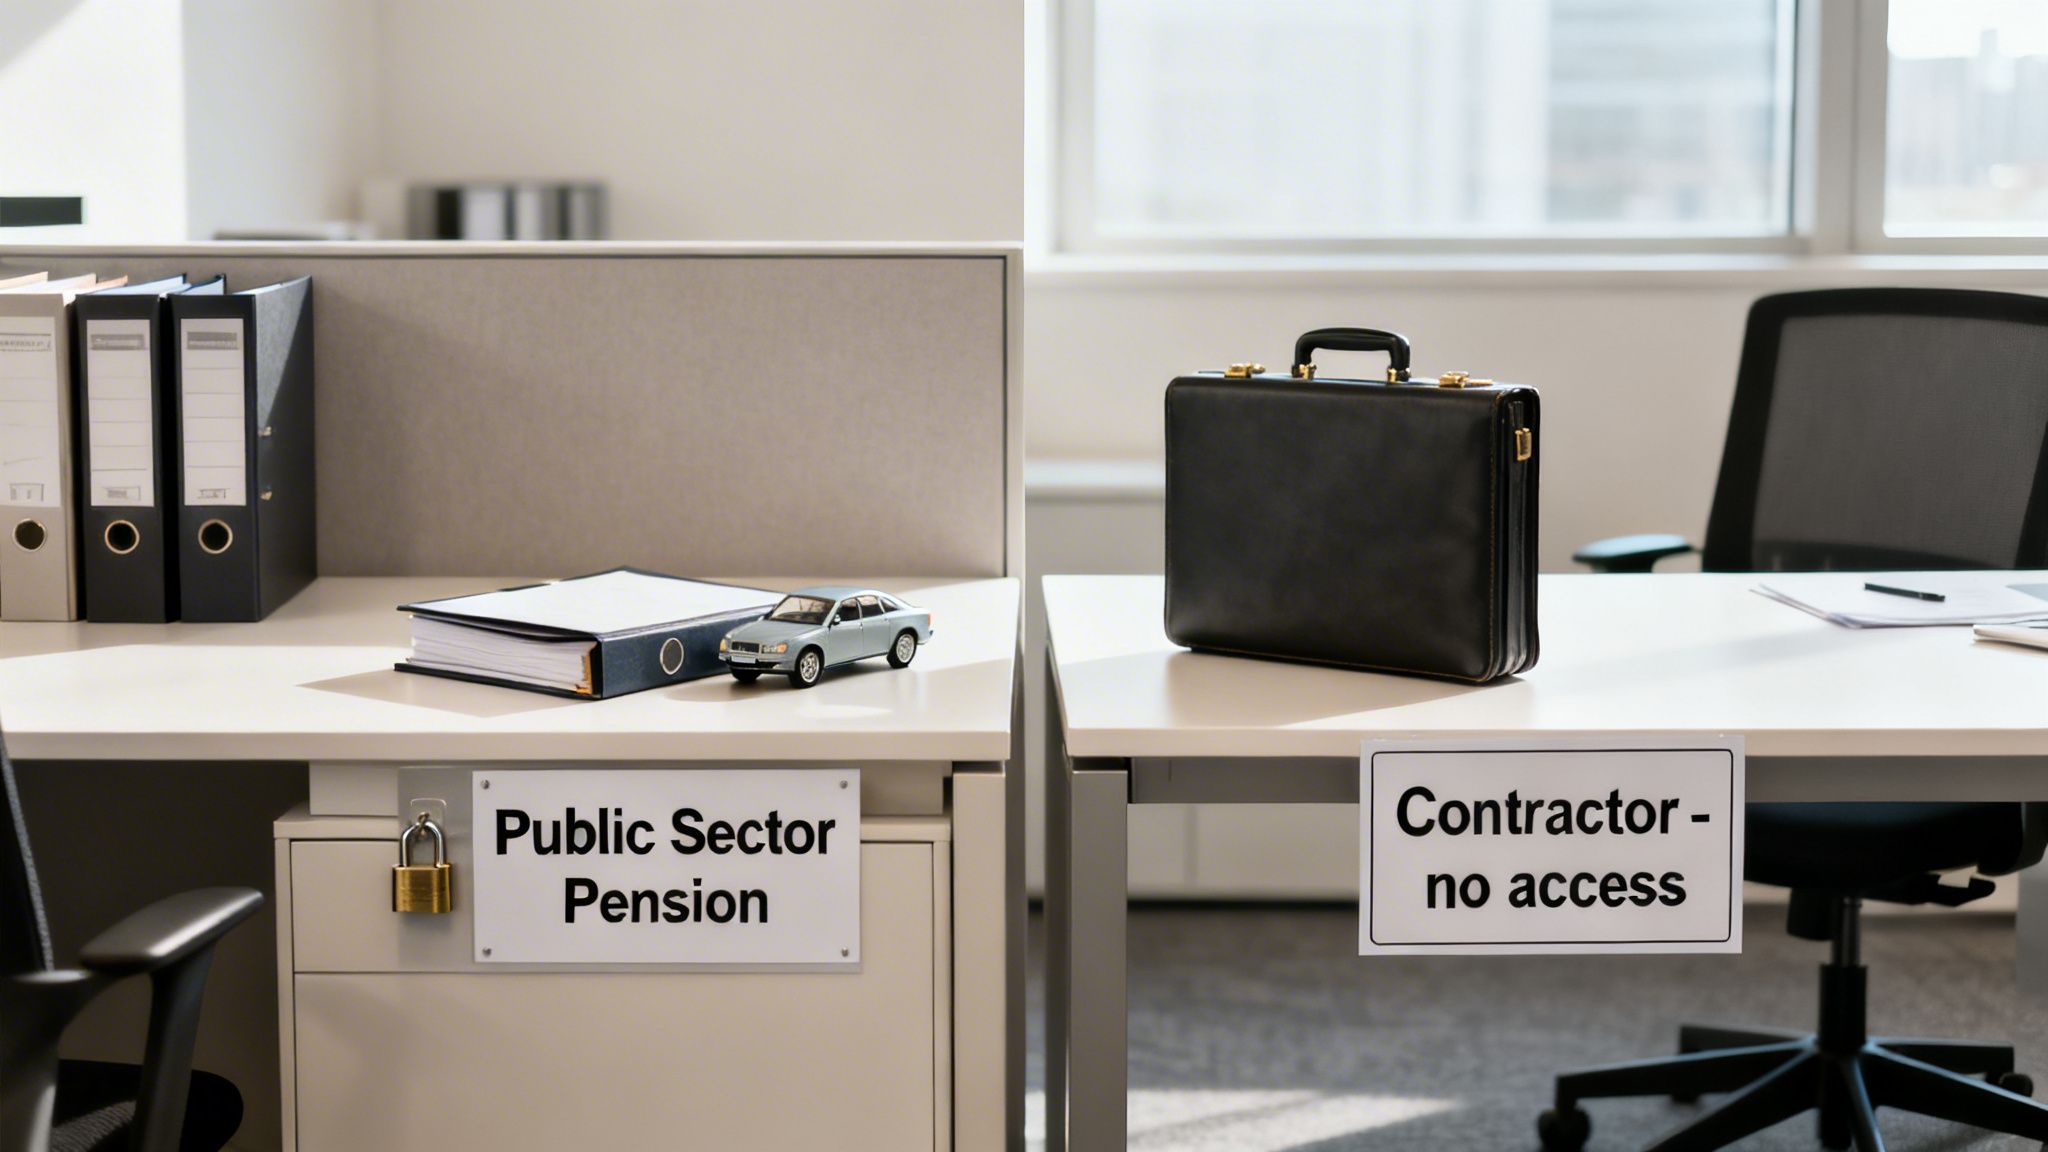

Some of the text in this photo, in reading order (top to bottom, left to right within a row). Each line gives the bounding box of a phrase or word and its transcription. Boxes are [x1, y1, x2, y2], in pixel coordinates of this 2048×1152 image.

[496, 807, 836, 856] Public Sector
[564, 877, 768, 924] Pension
[1427, 871, 1687, 909] no access
